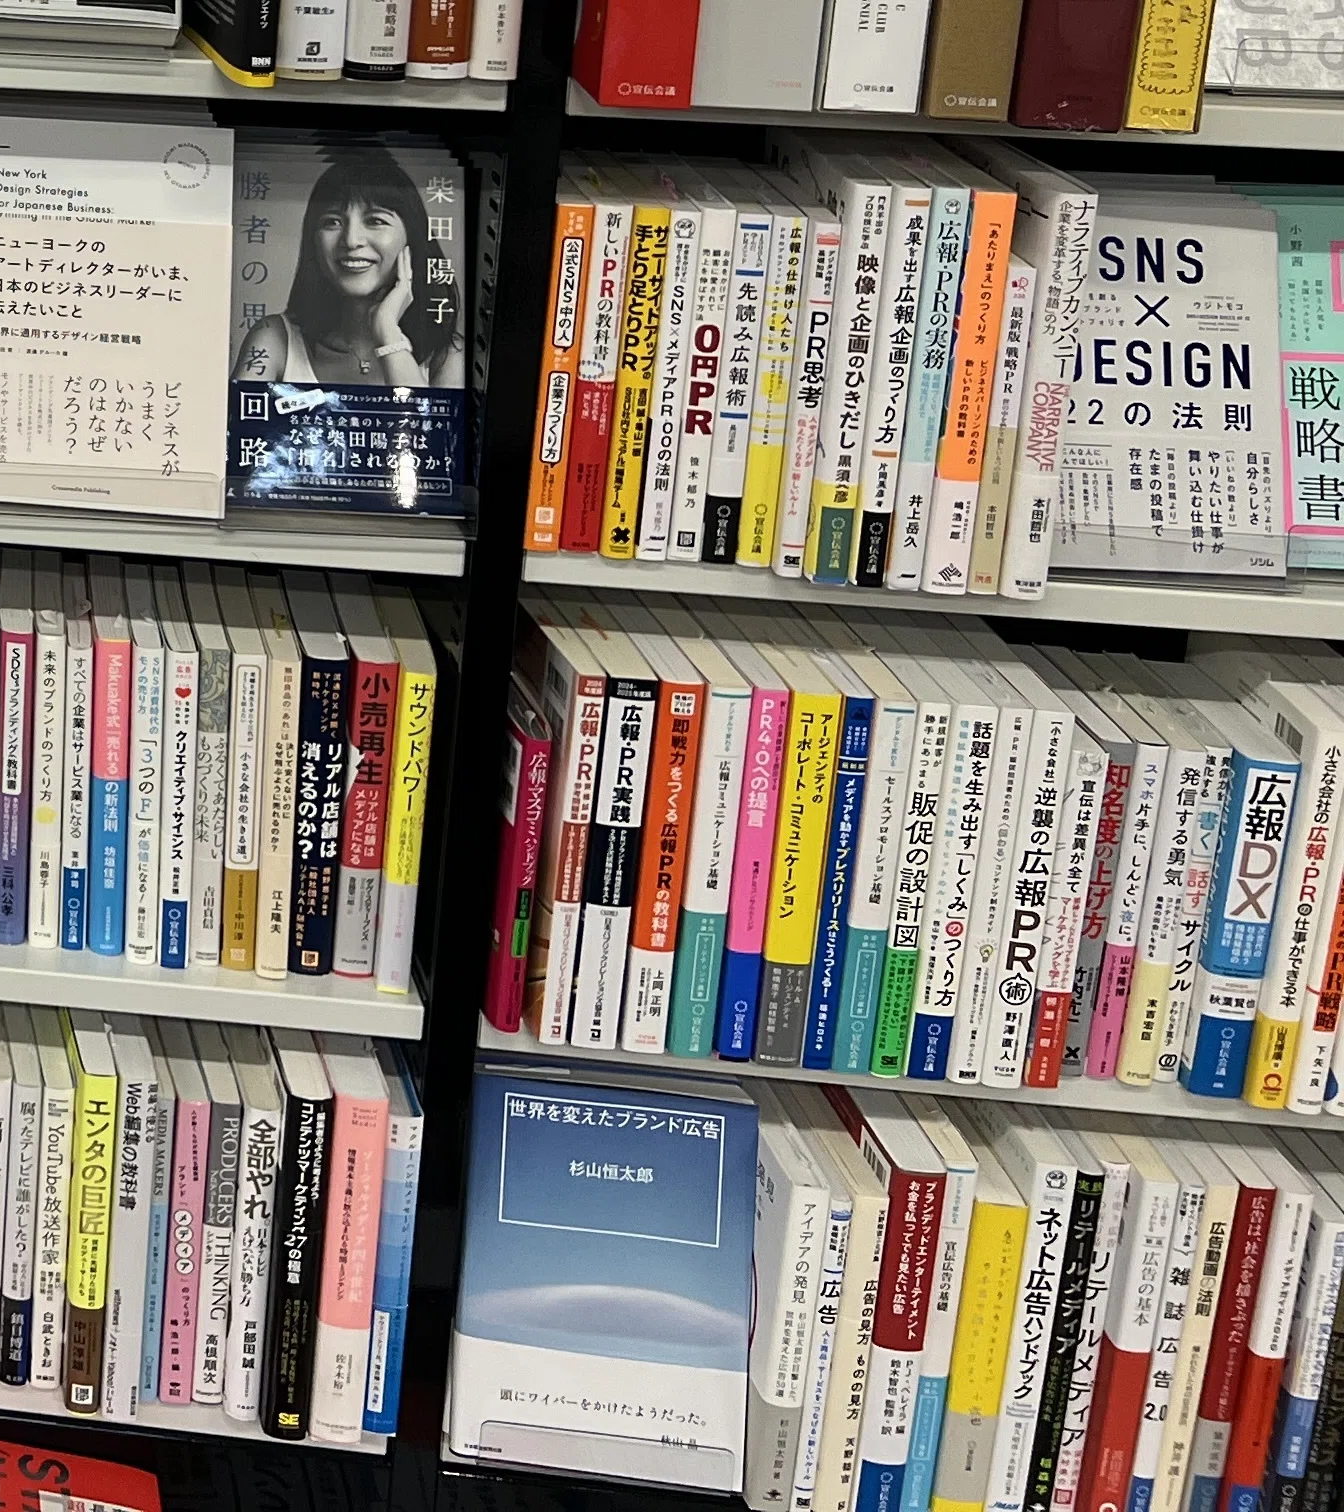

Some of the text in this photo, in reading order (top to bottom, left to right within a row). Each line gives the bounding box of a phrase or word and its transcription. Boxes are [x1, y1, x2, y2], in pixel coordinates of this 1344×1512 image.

[21, 168, 47, 179] York
[426, 176, 455, 325] 柴田陽子
[1099, 236, 1203, 284] SNS
[797, 311, 832, 409] PR思考
[830, 254, 885, 452] 映像と企画のひきだし
[296, 740, 321, 859] 消えるのか?
[400, 684, 427, 814] サウンドパワー
[894, 791, 938, 949] 販促の設計図
[78, 1099, 111, 1236] エンタの巨匠
[508, 1098, 721, 1142] 世界を変えたブランド広告
[567, 1159, 654, 1184] 杉山恒太郎
[207, 1233, 231, 1321] THINKING
[1011, 1207, 1064, 1402] ネット広告ハンドブック
